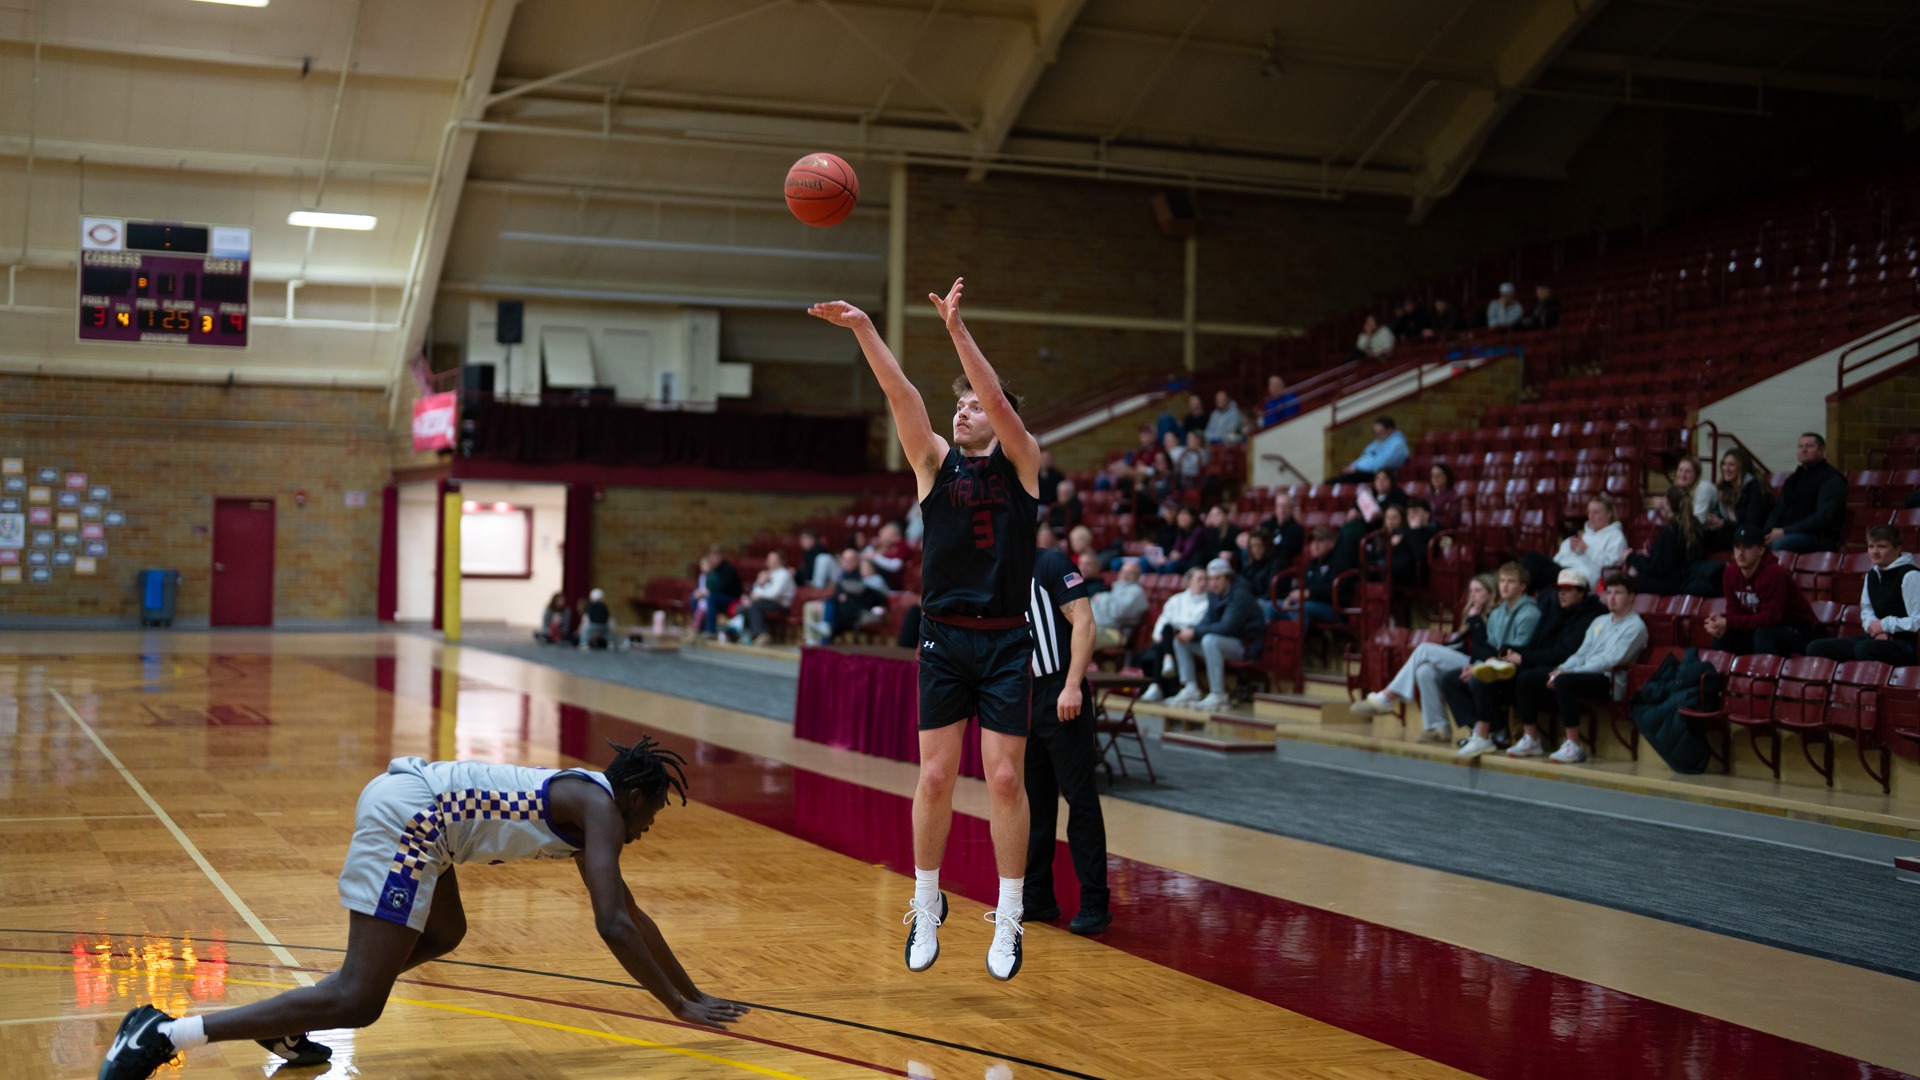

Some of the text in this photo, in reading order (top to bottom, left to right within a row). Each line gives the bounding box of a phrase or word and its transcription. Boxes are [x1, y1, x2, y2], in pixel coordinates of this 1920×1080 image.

[84, 252, 142, 269] COBBERS
[204, 258, 243, 274] GUEST
[93, 305, 106, 327] 3
[116, 312, 130, 327] 4
[162, 310, 190, 329] 25
[201, 315, 213, 333] 3
[972, 510, 995, 549] 3
